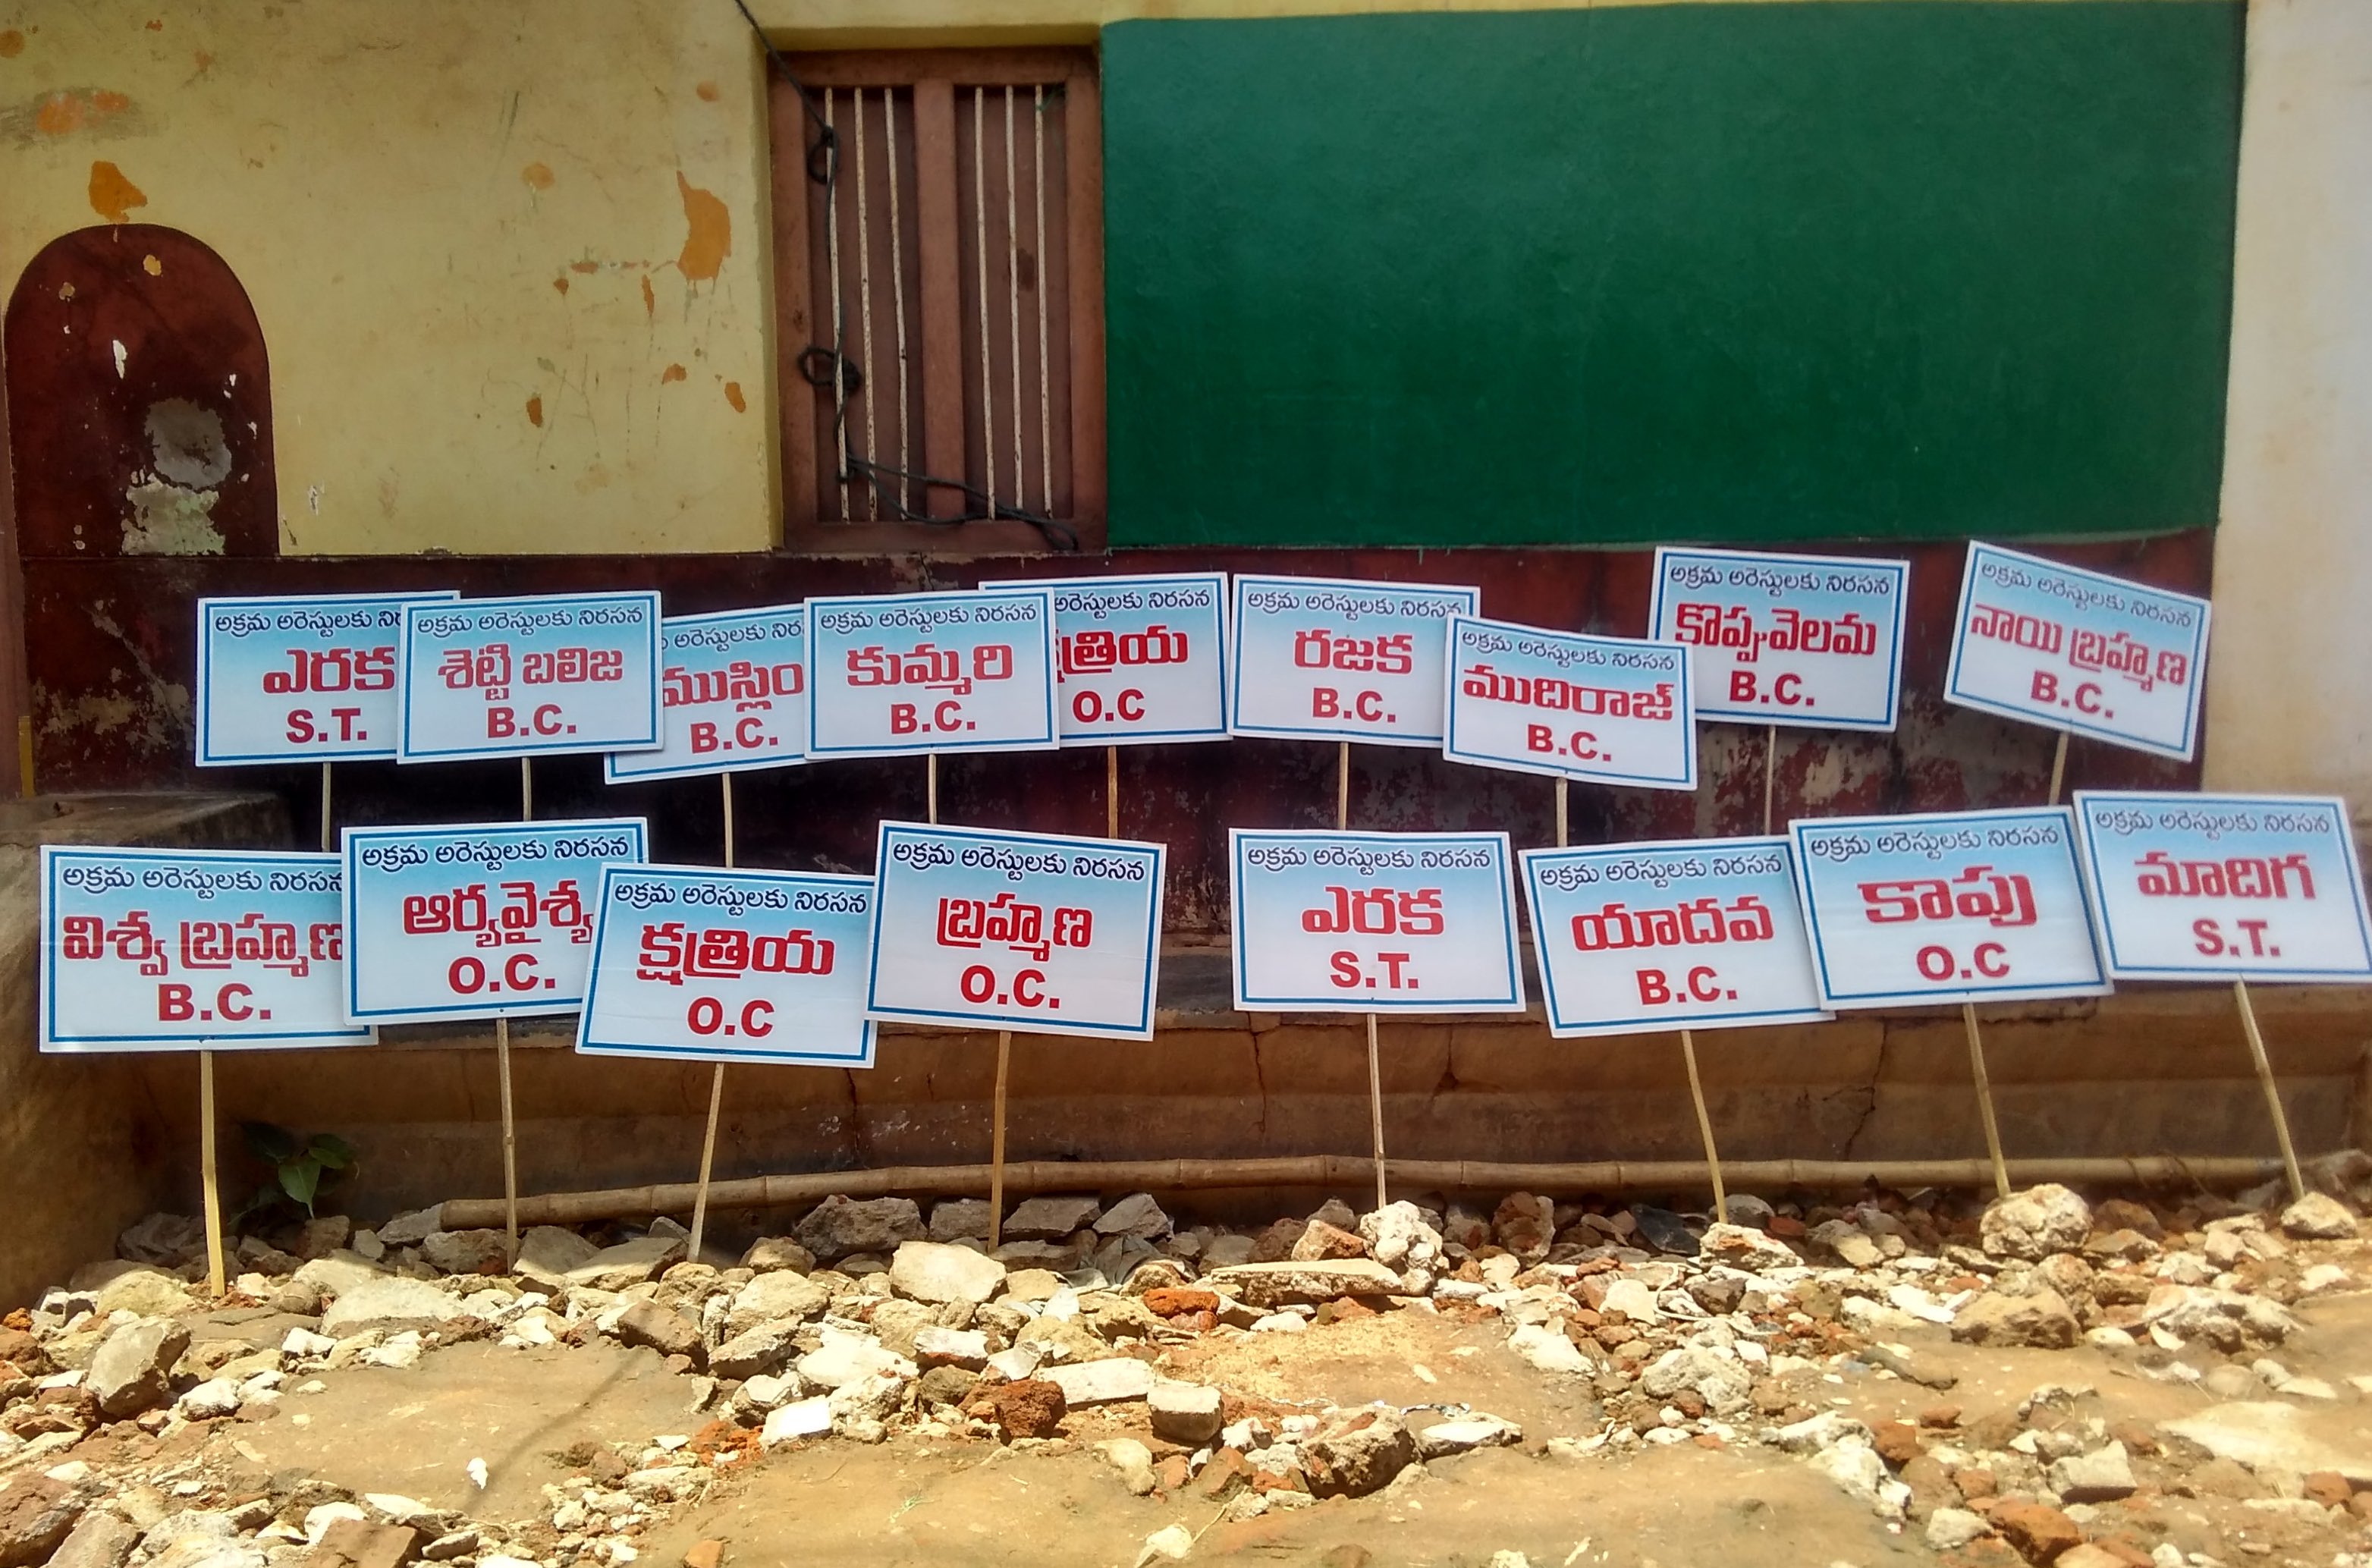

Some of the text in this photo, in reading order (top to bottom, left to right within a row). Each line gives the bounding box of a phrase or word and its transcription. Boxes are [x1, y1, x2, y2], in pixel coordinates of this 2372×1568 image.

[1670, 565, 1890, 595] అక్రమ అరెస్టులకు నిరసన
[1981, 564, 2192, 628] అక్రమ అరెస్టులకు నిరసన
[417, 614, 473, 638] అక్రమ
[478, 609, 573, 636] అరెస్టులకు
[578, 606, 642, 625] నిరసన
[821, 603, 1036, 635] అక్రమ అరెస్టులకు నిరసన
[1054, 589, 1210, 619] అరెస్టులకు నిరసన
[1248, 592, 1462, 621] అక్రమ అరెస్టులకు నిరసన
[215, 612, 272, 637] అక్రమ
[277, 610, 372, 637] అరెస్టులకు
[674, 624, 766, 652] అరెస్టులకు
[771, 621, 804, 639] నిర
[264, 648, 394, 693] ఎరక
[848, 644, 1013, 695] కుమ్మరి
[1056, 625, 1189, 683] త్రియ
[1295, 630, 1412, 674] రజక
[1462, 632, 1674, 671] అక్రమ అరెస్టులకు నిరసన
[439, 645, 622, 700] శెట్టి బలిజ
[1730, 671, 1814, 706] B.C.
[1073, 688, 1145, 724] O.C
[1313, 687, 1396, 722] B.C.
[1463, 664, 1672, 720] ముదిరాజ్
[2031, 670, 2114, 719] B.C.
[287, 709, 366, 743] S.T.
[489, 705, 575, 737] B.C.
[692, 718, 778, 753] B.C.
[891, 700, 976, 734] B.C.
[1528, 724, 1611, 762] B.C.
[2095, 810, 2330, 839] అక్రమ అరెస్టులకు నిరసన
[362, 836, 629, 872] అక్రమ అరెస్టులకు నిరసన
[893, 842, 1145, 881] అక్రమ అరెస్టులకు నిరసన
[1248, 846, 1491, 875] అక్రమ అరెస్టులకు నిరసన
[1811, 825, 2059, 863] అక్రమ అరెస్టులకు నిరసన
[63, 866, 135, 894] అక్రమ
[143, 867, 262, 900] అరెస్టులకు
[1541, 853, 1784, 891] అక్రమ అరెస్టులకు నిరసన
[2135, 851, 2316, 900] మాదిగ
[614, 882, 866, 916] అక్రమ అరెస్టులకు నిరసన
[1302, 886, 1444, 935] ఎరక
[1859, 866, 2037, 926] కాపు
[1571, 896, 1774, 951] యాదవ
[2192, 919, 2281, 957] S.T.
[64, 912, 168, 975] విశ్వ
[636, 922, 834, 985] క్షత్రియ
[1917, 943, 2009, 981] O.C
[449, 954, 555, 994] O.C.
[960, 964, 1060, 1009] O.C.
[1331, 951, 1418, 989] S.T.
[1636, 966, 1736, 1005] B.C.
[159, 983, 271, 1021] B.C.
[688, 997, 774, 1038] O.C
